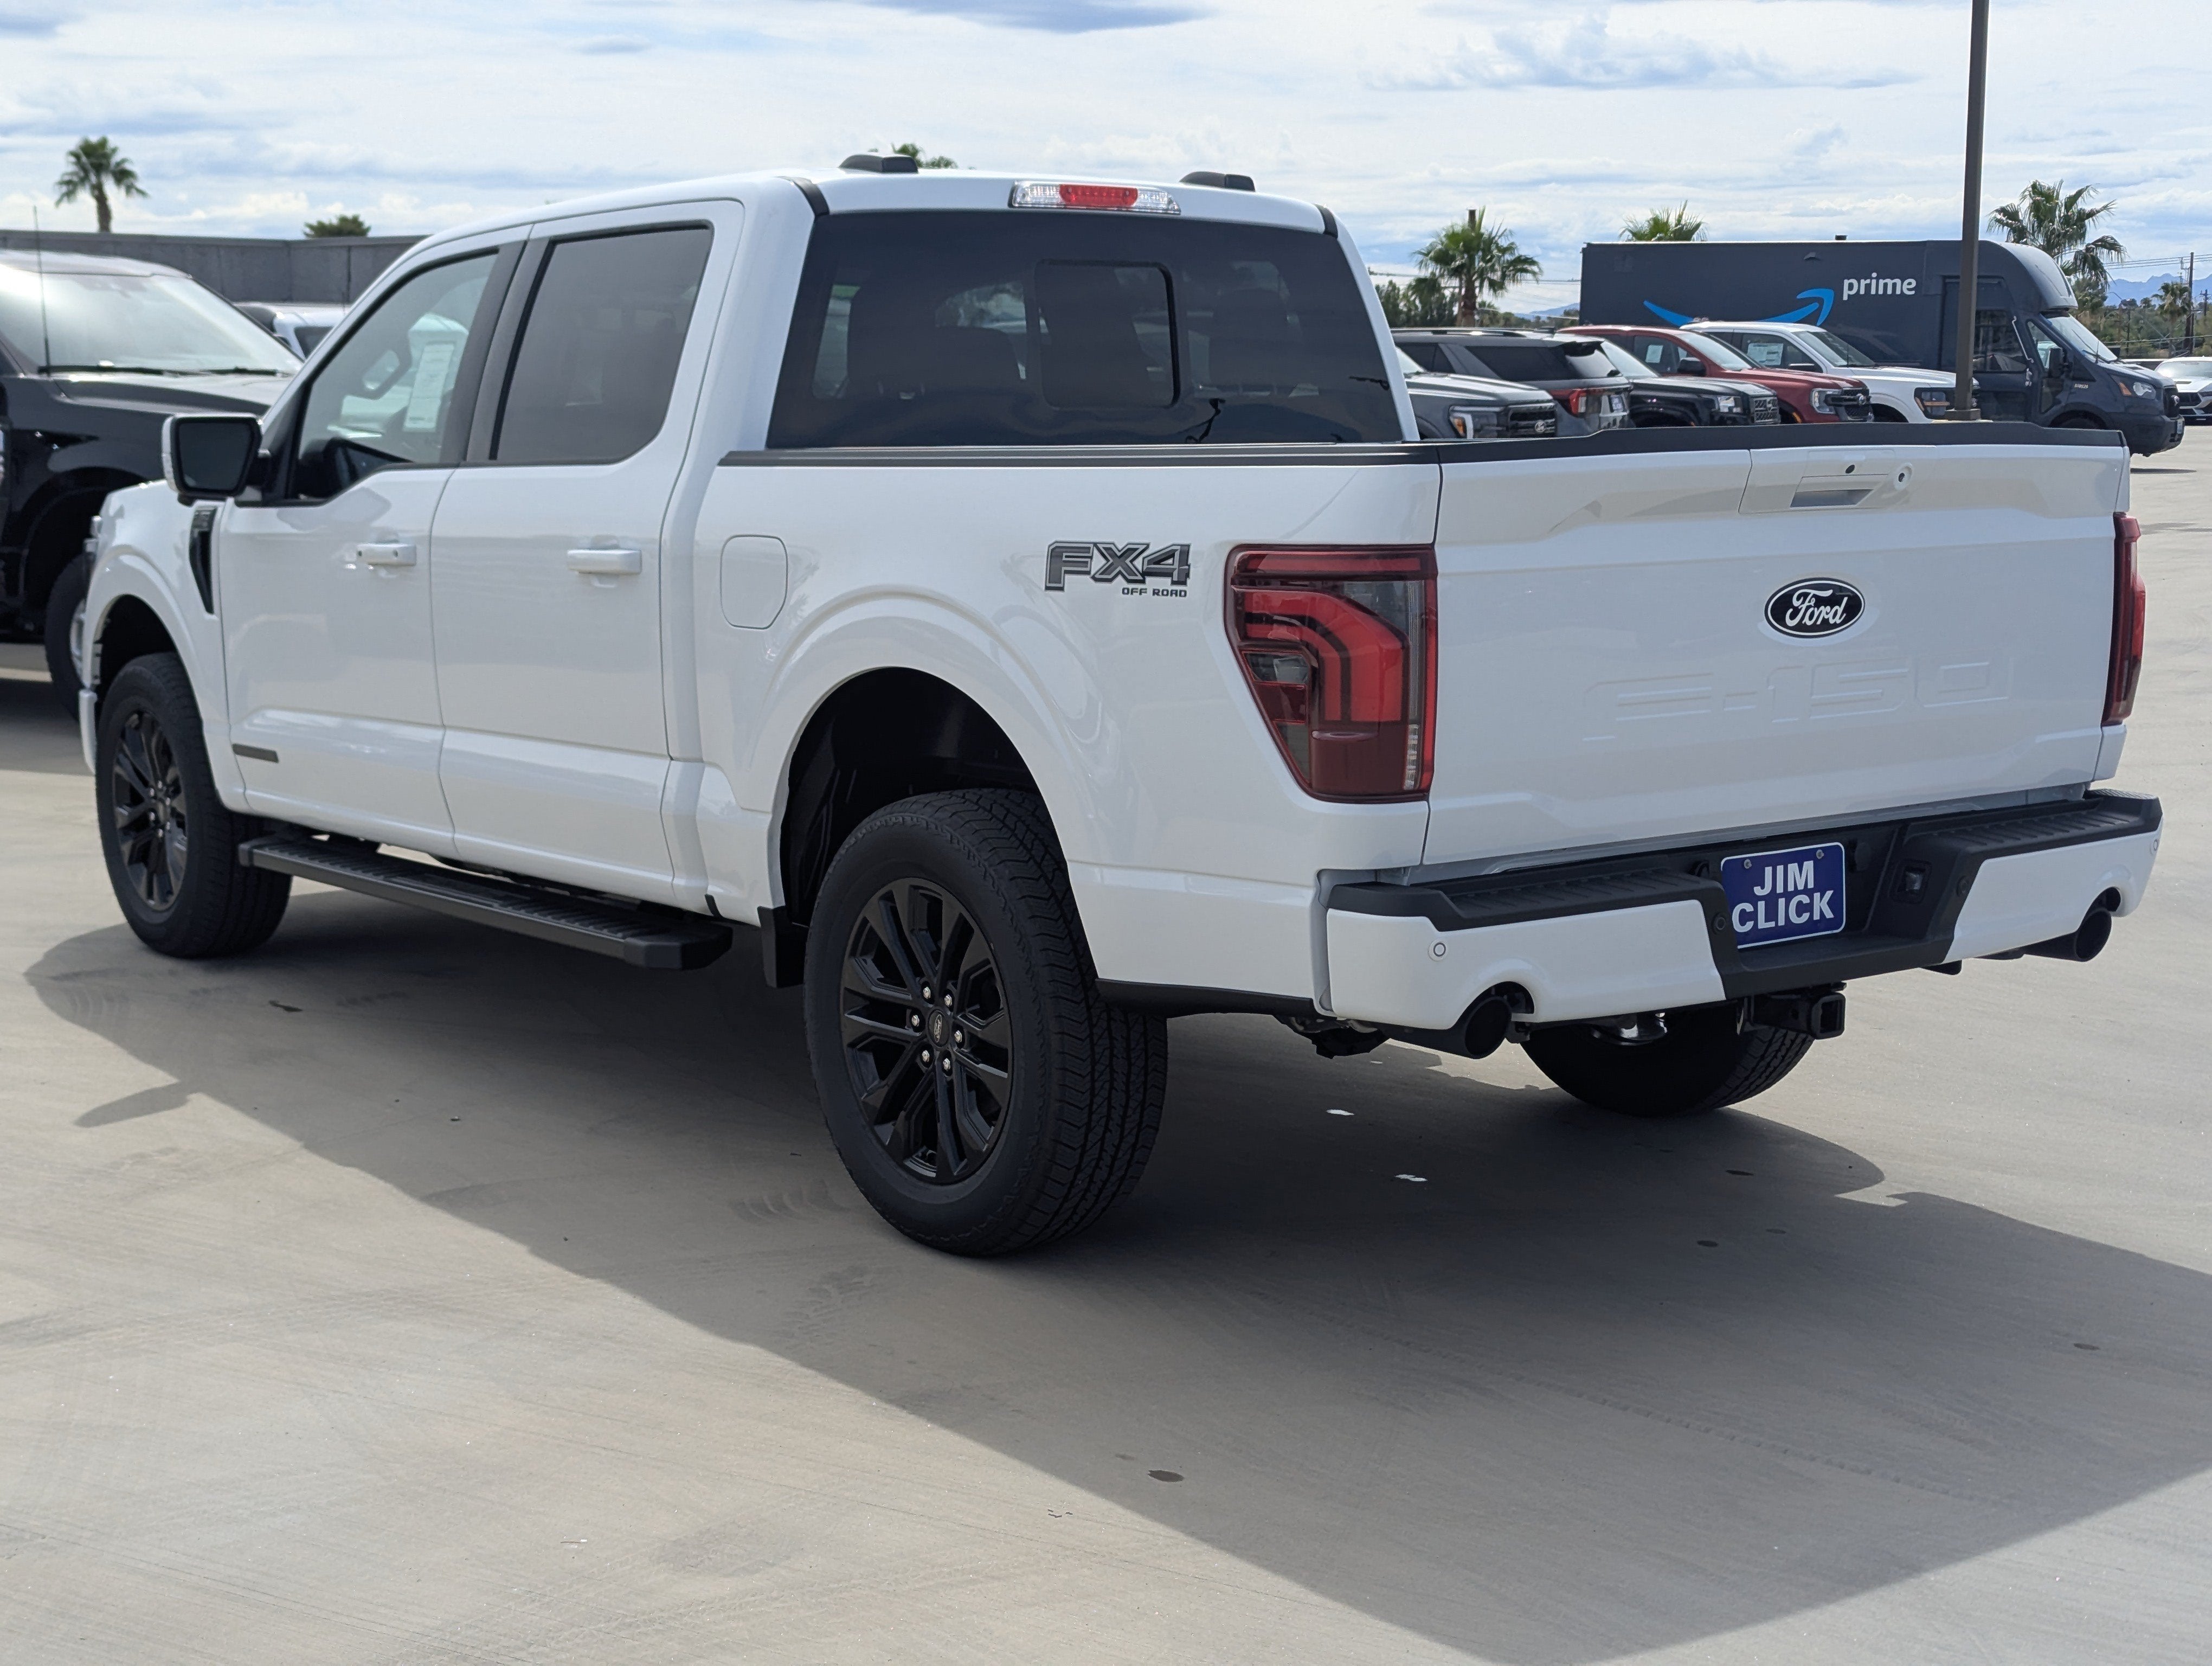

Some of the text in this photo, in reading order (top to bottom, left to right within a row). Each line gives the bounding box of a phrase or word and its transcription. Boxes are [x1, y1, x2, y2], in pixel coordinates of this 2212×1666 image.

[1843, 272, 1917, 300] prime
[1045, 541, 1192, 592] FX4
[1122, 587, 1187, 598] OFF ROAD
[1785, 589, 1846, 627] Ford
[1583, 655, 2012, 741] F-150
[1753, 860, 1814, 896] JIM
[1732, 890, 1835, 933] CLICK
